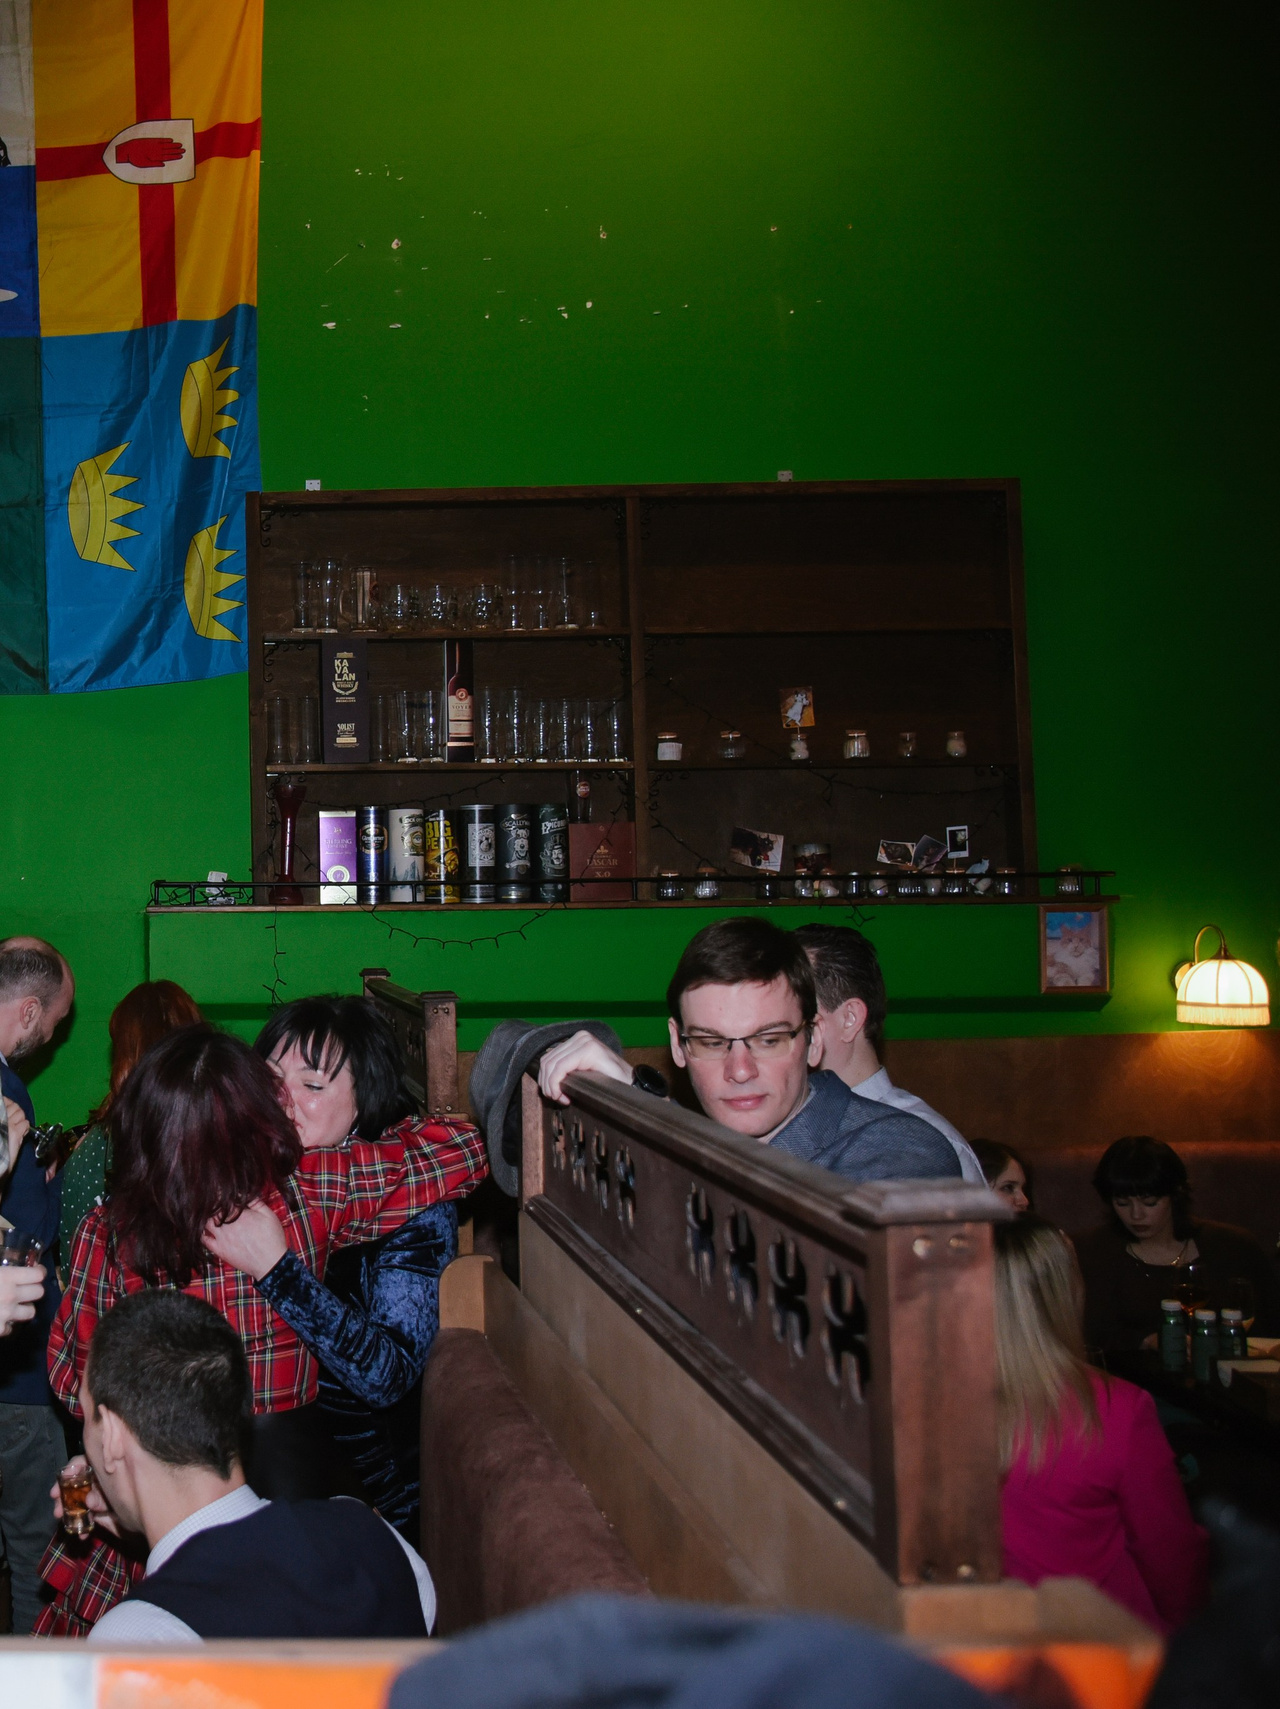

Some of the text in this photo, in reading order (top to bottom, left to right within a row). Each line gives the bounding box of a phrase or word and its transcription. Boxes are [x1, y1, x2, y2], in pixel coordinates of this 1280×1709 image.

[334, 659, 349, 667] KA
[334, 666, 349, 674] VA
[334, 673, 356, 681] LAN
[425, 820, 452, 838] BIG
